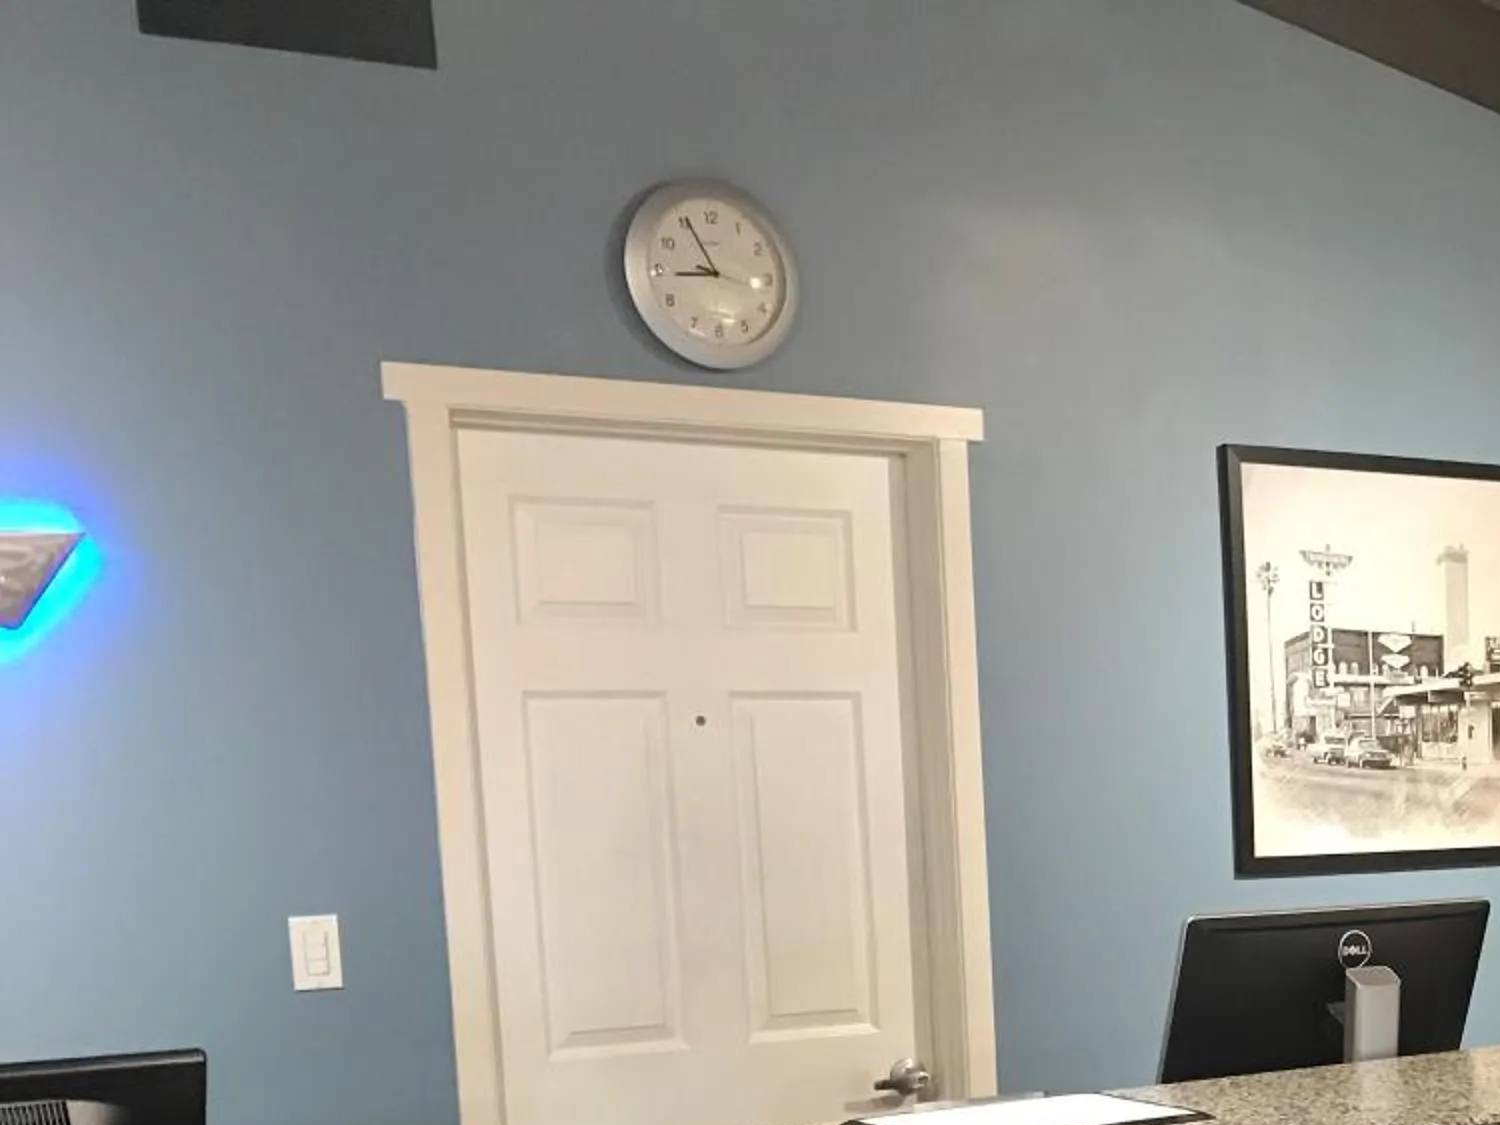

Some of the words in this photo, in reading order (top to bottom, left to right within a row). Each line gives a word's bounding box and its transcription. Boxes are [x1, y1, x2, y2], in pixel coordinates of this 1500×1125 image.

[703, 211, 719, 225] 12
[661, 237, 675, 250] 10
[753, 242, 763, 256] 2
[665, 294, 675, 308] 8
[690, 316, 699, 329] 7
[740, 319, 749, 333] 5
[714, 324, 724, 338] 6
[1310, 581, 1329, 688] LODGE
[1343, 945, 1367, 957] DELL
